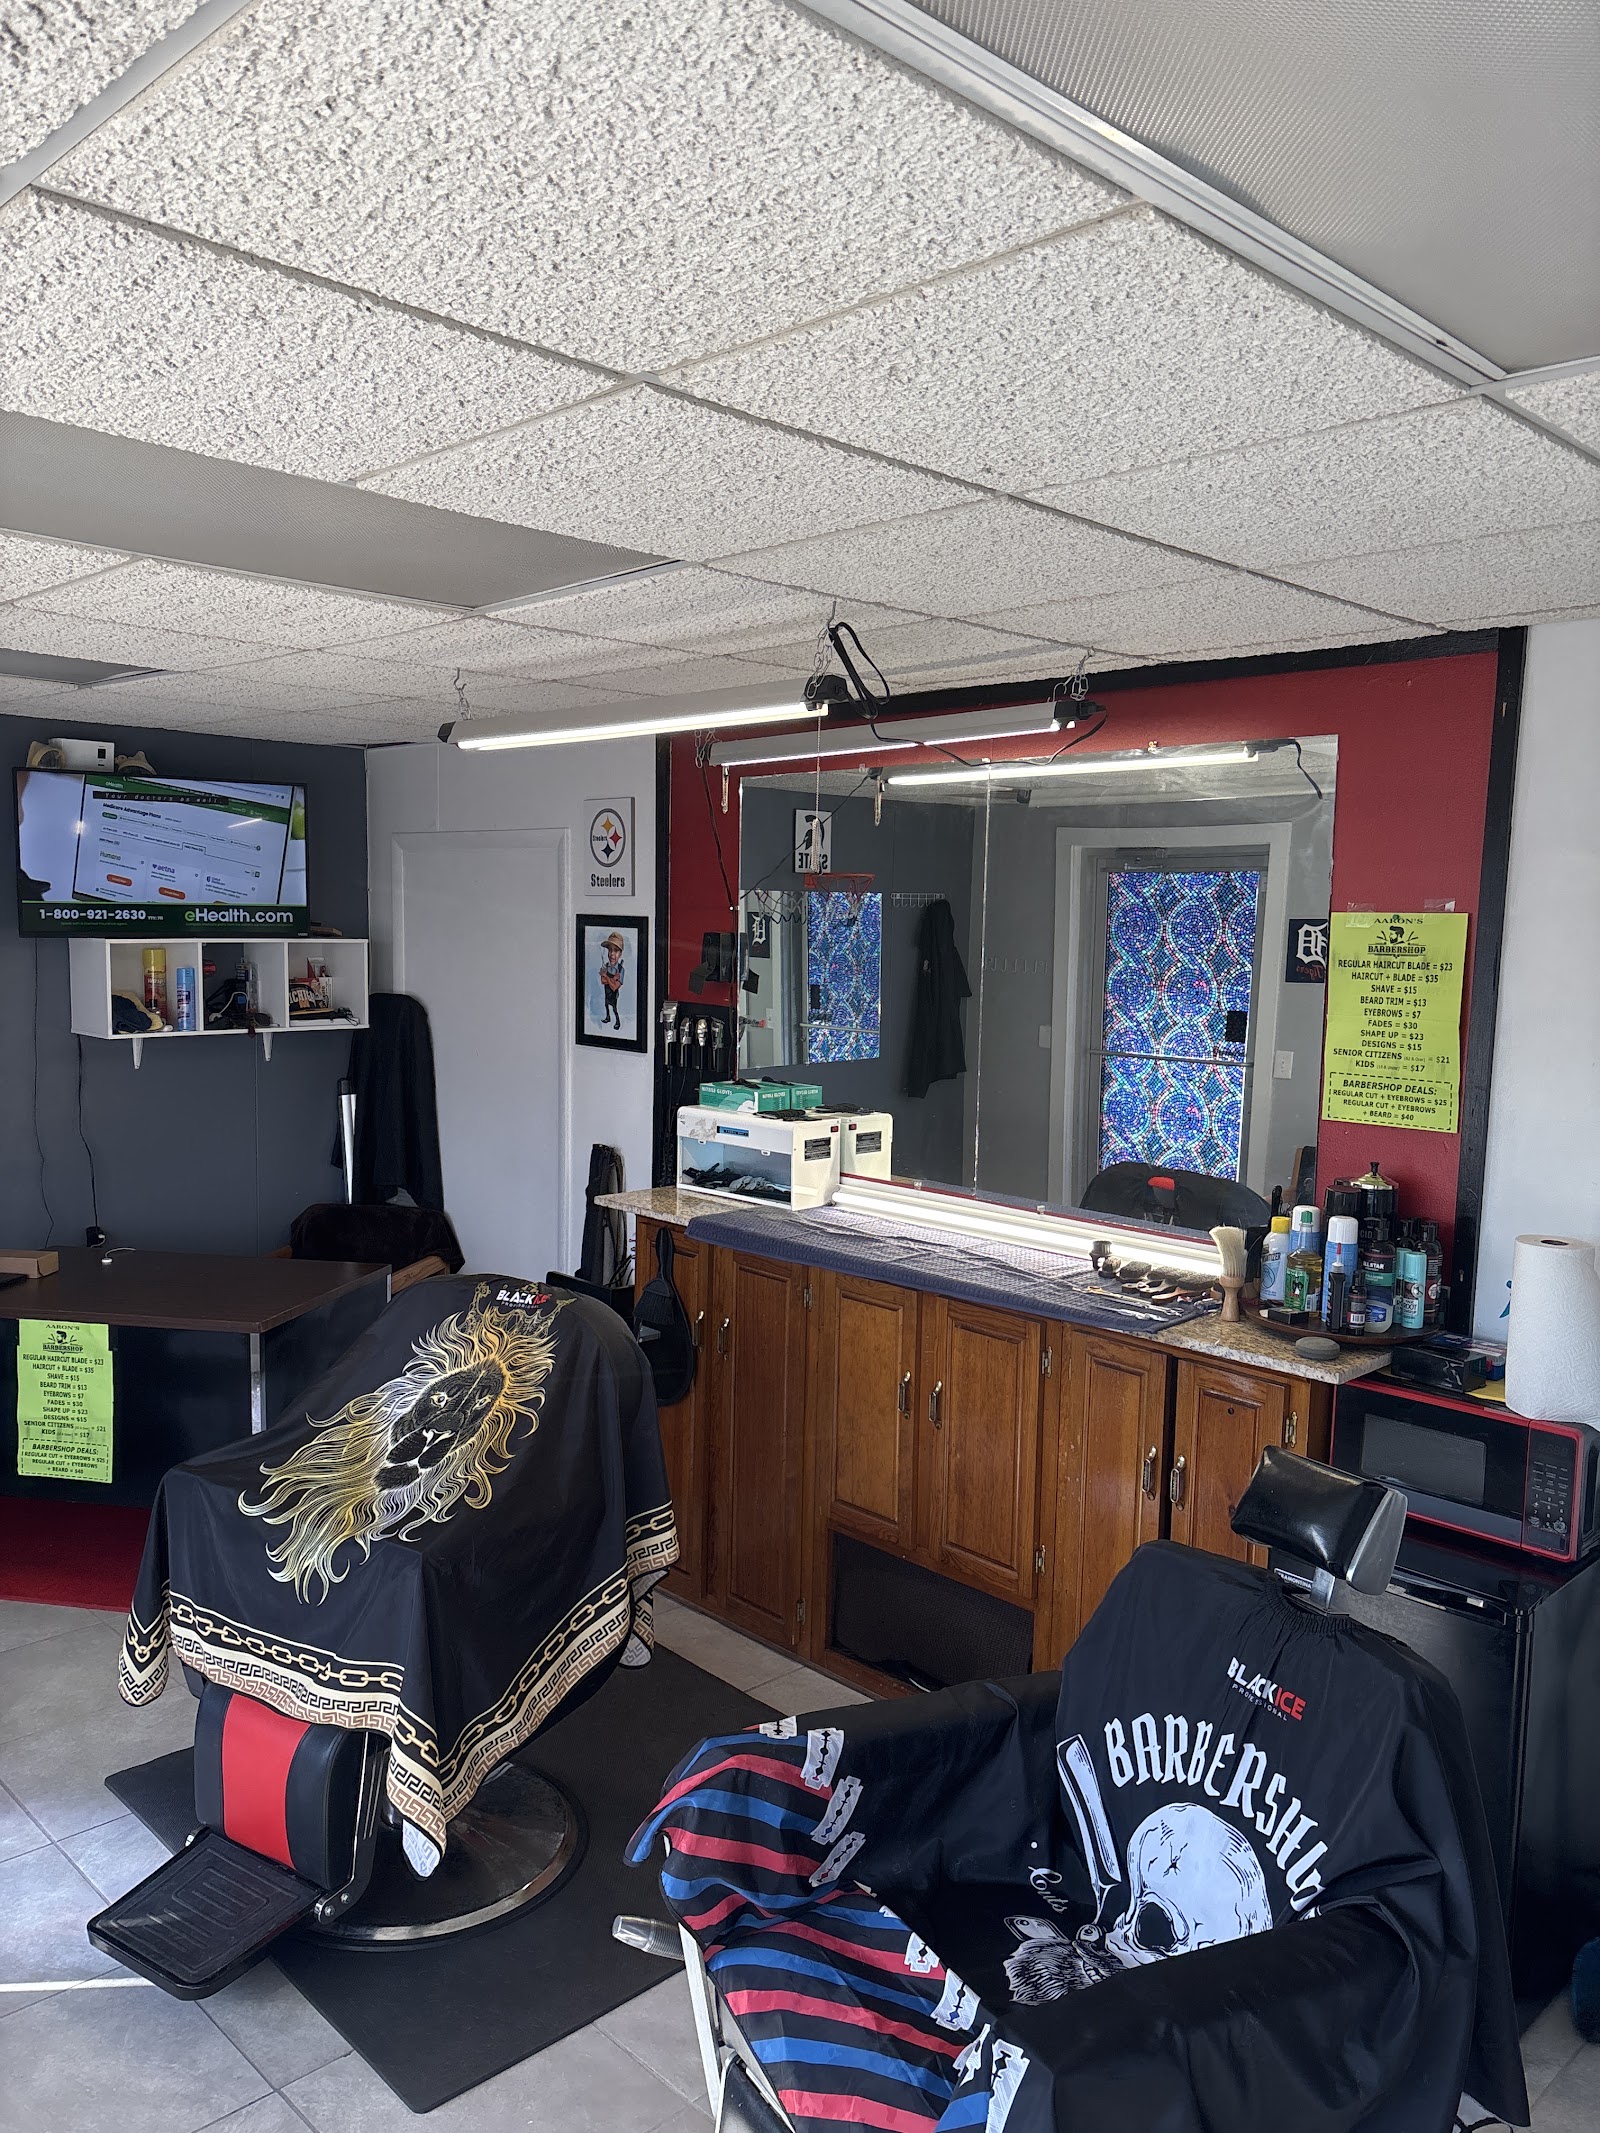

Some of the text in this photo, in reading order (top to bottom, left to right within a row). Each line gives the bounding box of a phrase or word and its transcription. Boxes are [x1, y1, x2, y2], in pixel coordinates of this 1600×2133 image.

[135, 794, 173, 802] doctors
[157, 865, 175, 874] aetna
[590, 873, 625, 888] Steelers
[39, 908, 147, 920] 1-800-921-2630
[184, 907, 293, 923] eHealth.com
[1368, 946, 1426, 954] BARBERSHOP
[1338, 959, 1371, 968] REGULAR
[1374, 960, 1405, 969] HAIRCUT
[1407, 961, 1430, 970] BLADE
[1440, 962, 1453, 972] $23
[1352, 972, 1384, 980] HAIRCUT
[1393, 973, 1415, 982] BLADE
[1425, 974, 1439, 983] $35
[1371, 984, 1394, 993] SHAVE
[1404, 986, 1417, 995] $15
[1360, 996, 1384, 1005] BEARD
[1386, 997, 1404, 1005] TRIM
[1413, 999, 1427, 1008] $13
[1364, 1008, 1403, 1017] EYEBROWS
[1412, 1011, 1421, 1019] $7
[1368, 1020, 1392, 1028] FADES
[1403, 1022, 1418, 1030] $30
[1360, 1029, 1386, 1038] SHAPE
[1361, 1040, 1396, 1049] DESIGNS
[1407, 1043, 1422, 1051] $15
[1333, 1048, 1362, 1057] SENIOR
[1365, 1050, 1402, 1059] CITIZENS
[1436, 1056, 1450, 1064] $21
[1355, 1060, 1374, 1068] KIDS
[1343, 1080, 1437, 1095] BARBERSHOP DEALS:
[1333, 1089, 1363, 1098] REGULAR
[1387, 1094, 1425, 1104] EYEBROWS
[1343, 1099, 1374, 1108] REGULAR
[1398, 1104, 1436, 1114] EYEBROWS
[1370, 1110, 1392, 1118] BEARD
[48, 1355, 70, 1363] HAIRCUT
[43, 1390, 71, 1398] EYEBROWS
[32, 1444, 75, 1453] BARBERSHOP
